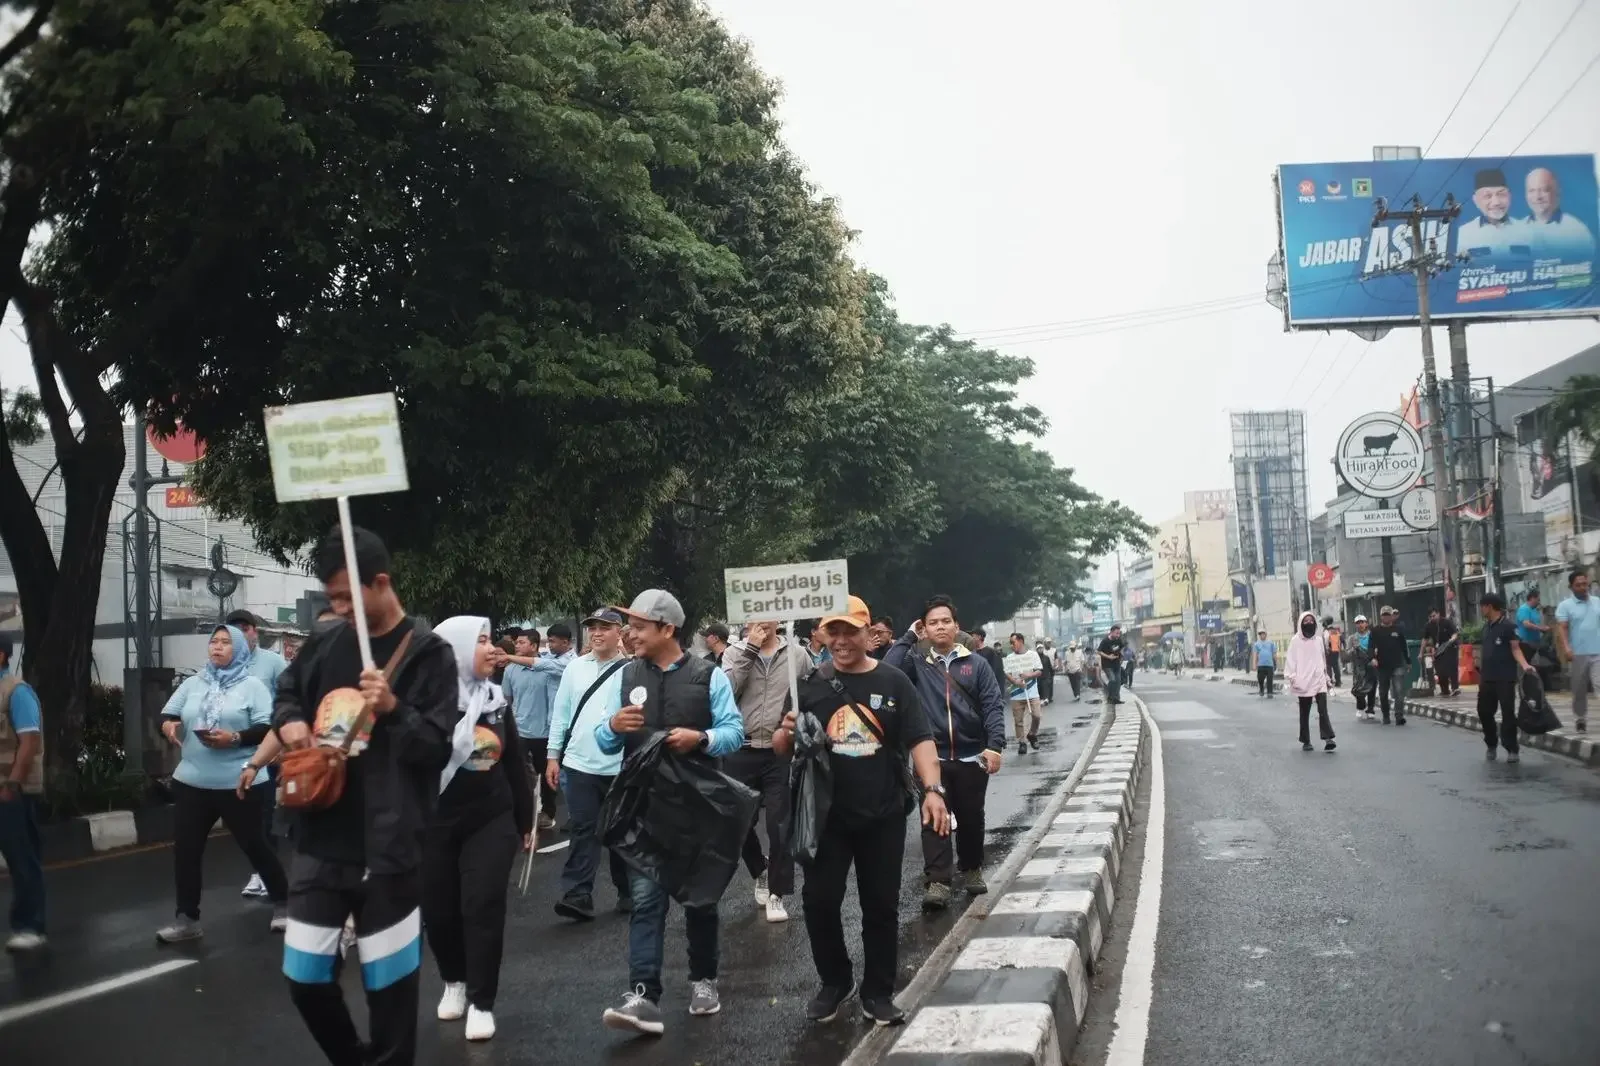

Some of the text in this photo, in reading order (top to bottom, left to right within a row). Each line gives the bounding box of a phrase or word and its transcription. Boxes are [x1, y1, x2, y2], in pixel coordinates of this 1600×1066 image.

[1299, 237, 1362, 268] JABAR
[1458, 269, 1528, 290] SYAIKHU
[168, 491, 186, 504] 24
[731, 570, 843, 595] Everyday is
[1171, 572, 1199, 582] CAT
[742, 594, 834, 613] Earth day
